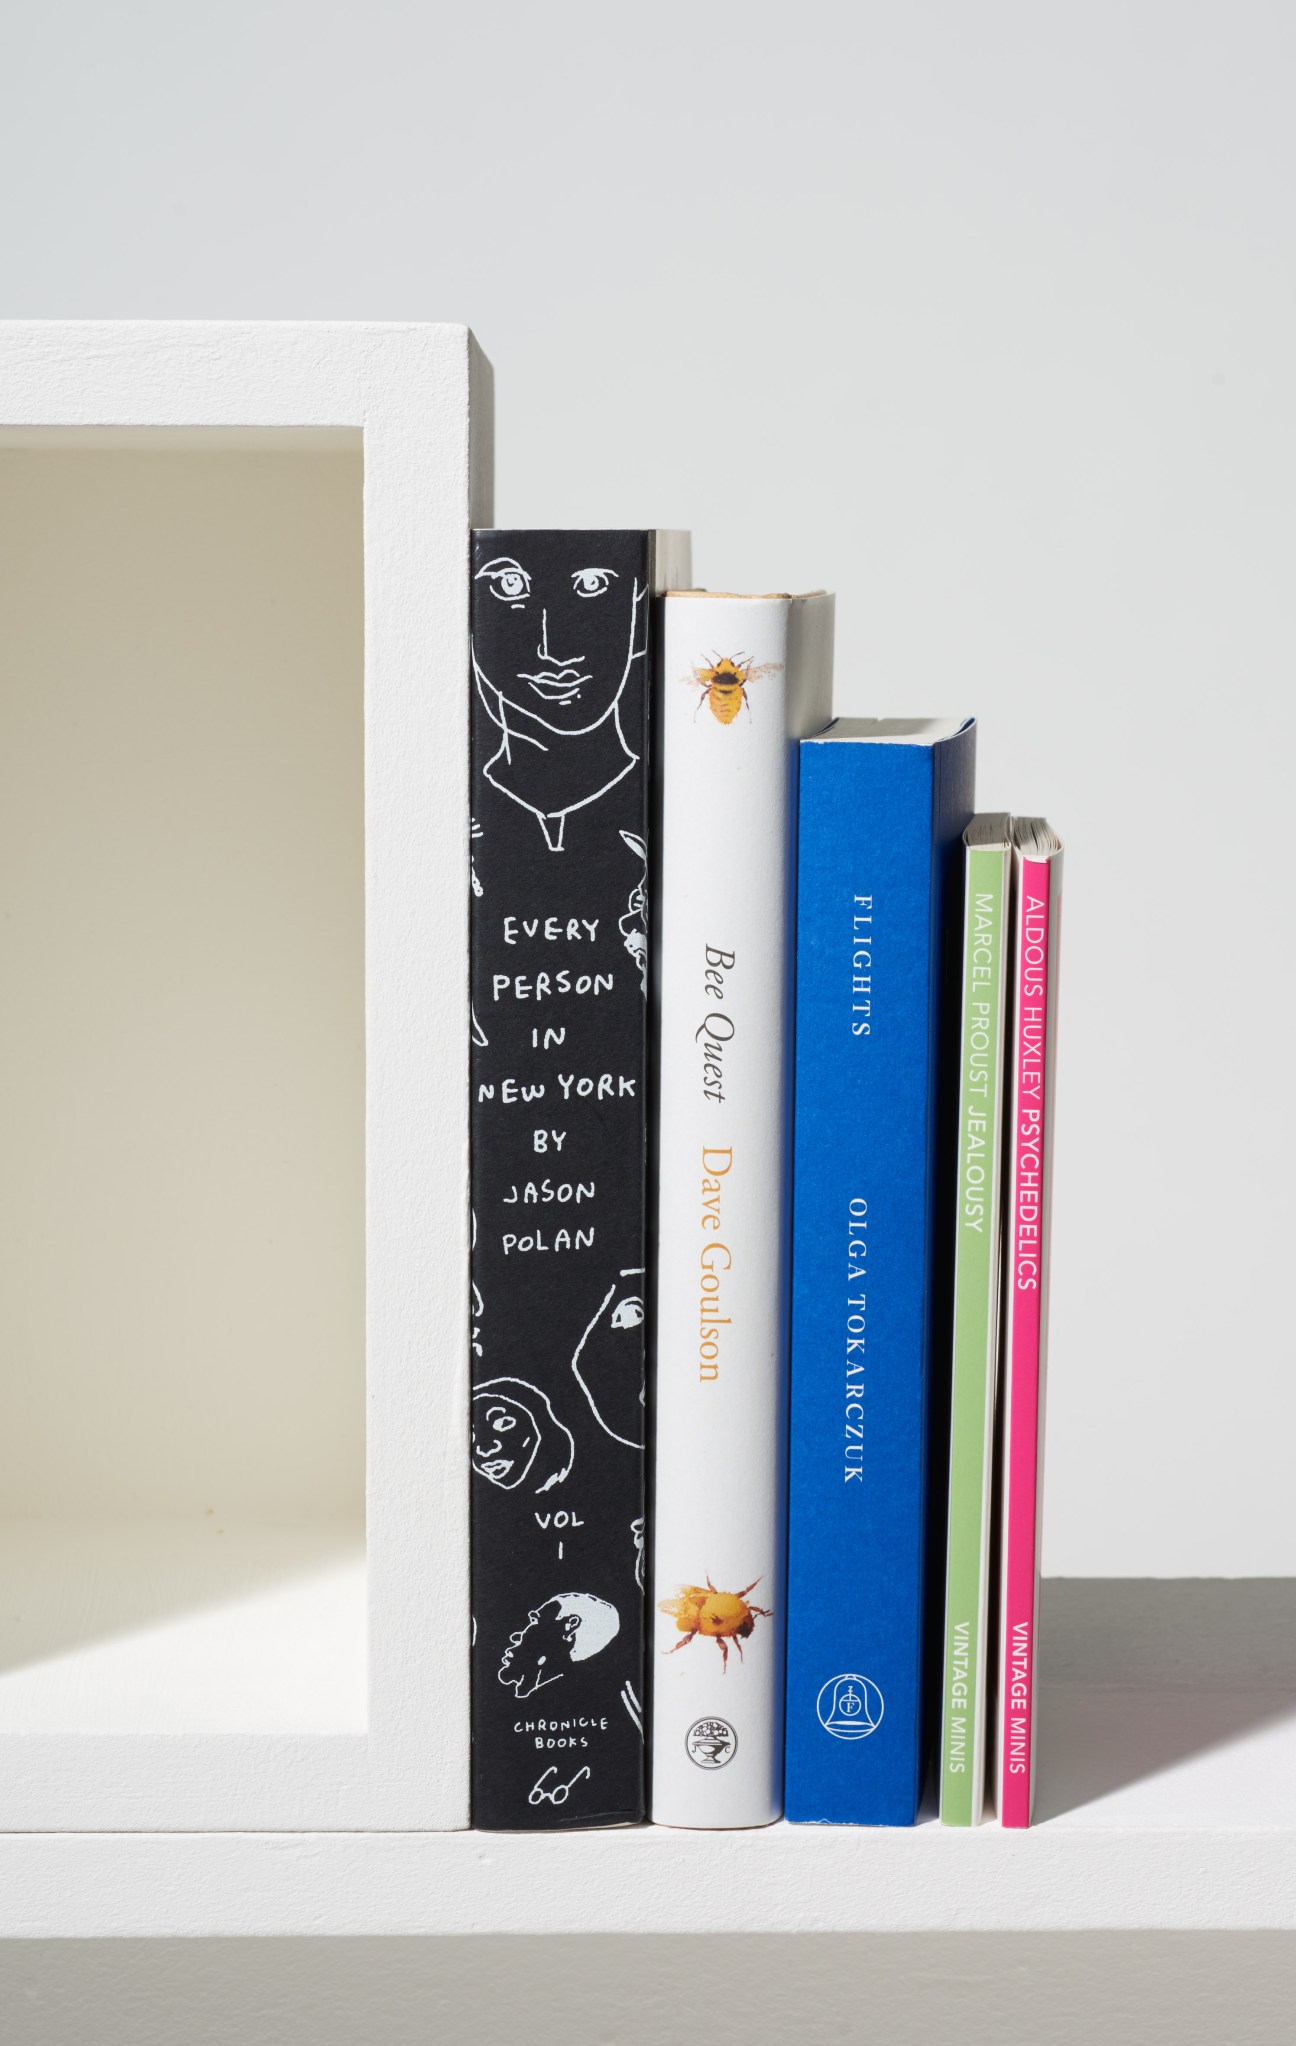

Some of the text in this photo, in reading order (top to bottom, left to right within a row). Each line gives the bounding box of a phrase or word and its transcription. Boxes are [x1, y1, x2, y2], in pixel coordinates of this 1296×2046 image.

[503, 916, 600, 945] EVERY
[851, 894, 873, 1036] FLIGHTS
[492, 969, 614, 1002] PERSON
[531, 1027, 566, 1050] IN
[695, 943, 736, 1104] Bee Quest
[964, 893, 995, 1233] MARCEL PROUST JEALOUSY
[477, 1073, 637, 1104] NEW YORK
[1017, 894, 1046, 1291] ALDOUS HUXLEY PSYCHEDELICS
[533, 1129, 567, 1154] BY
[502, 1178, 596, 1204] JASON
[502, 1226, 595, 1256] POLAN
[698, 1147, 734, 1383] Dave Goulson
[844, 1197, 868, 1483] OLGA TOKARCZUK
[534, 1510, 585, 1530] VOL
[846, 1701, 855, 1713] F
[948, 1621, 970, 1773] VINTAGE MINIS
[1009, 1621, 1029, 1774] VINTAGE MINIS
[513, 1717, 609, 1733] CHRONICLE
[534, 1736, 588, 1750] BOOKS
